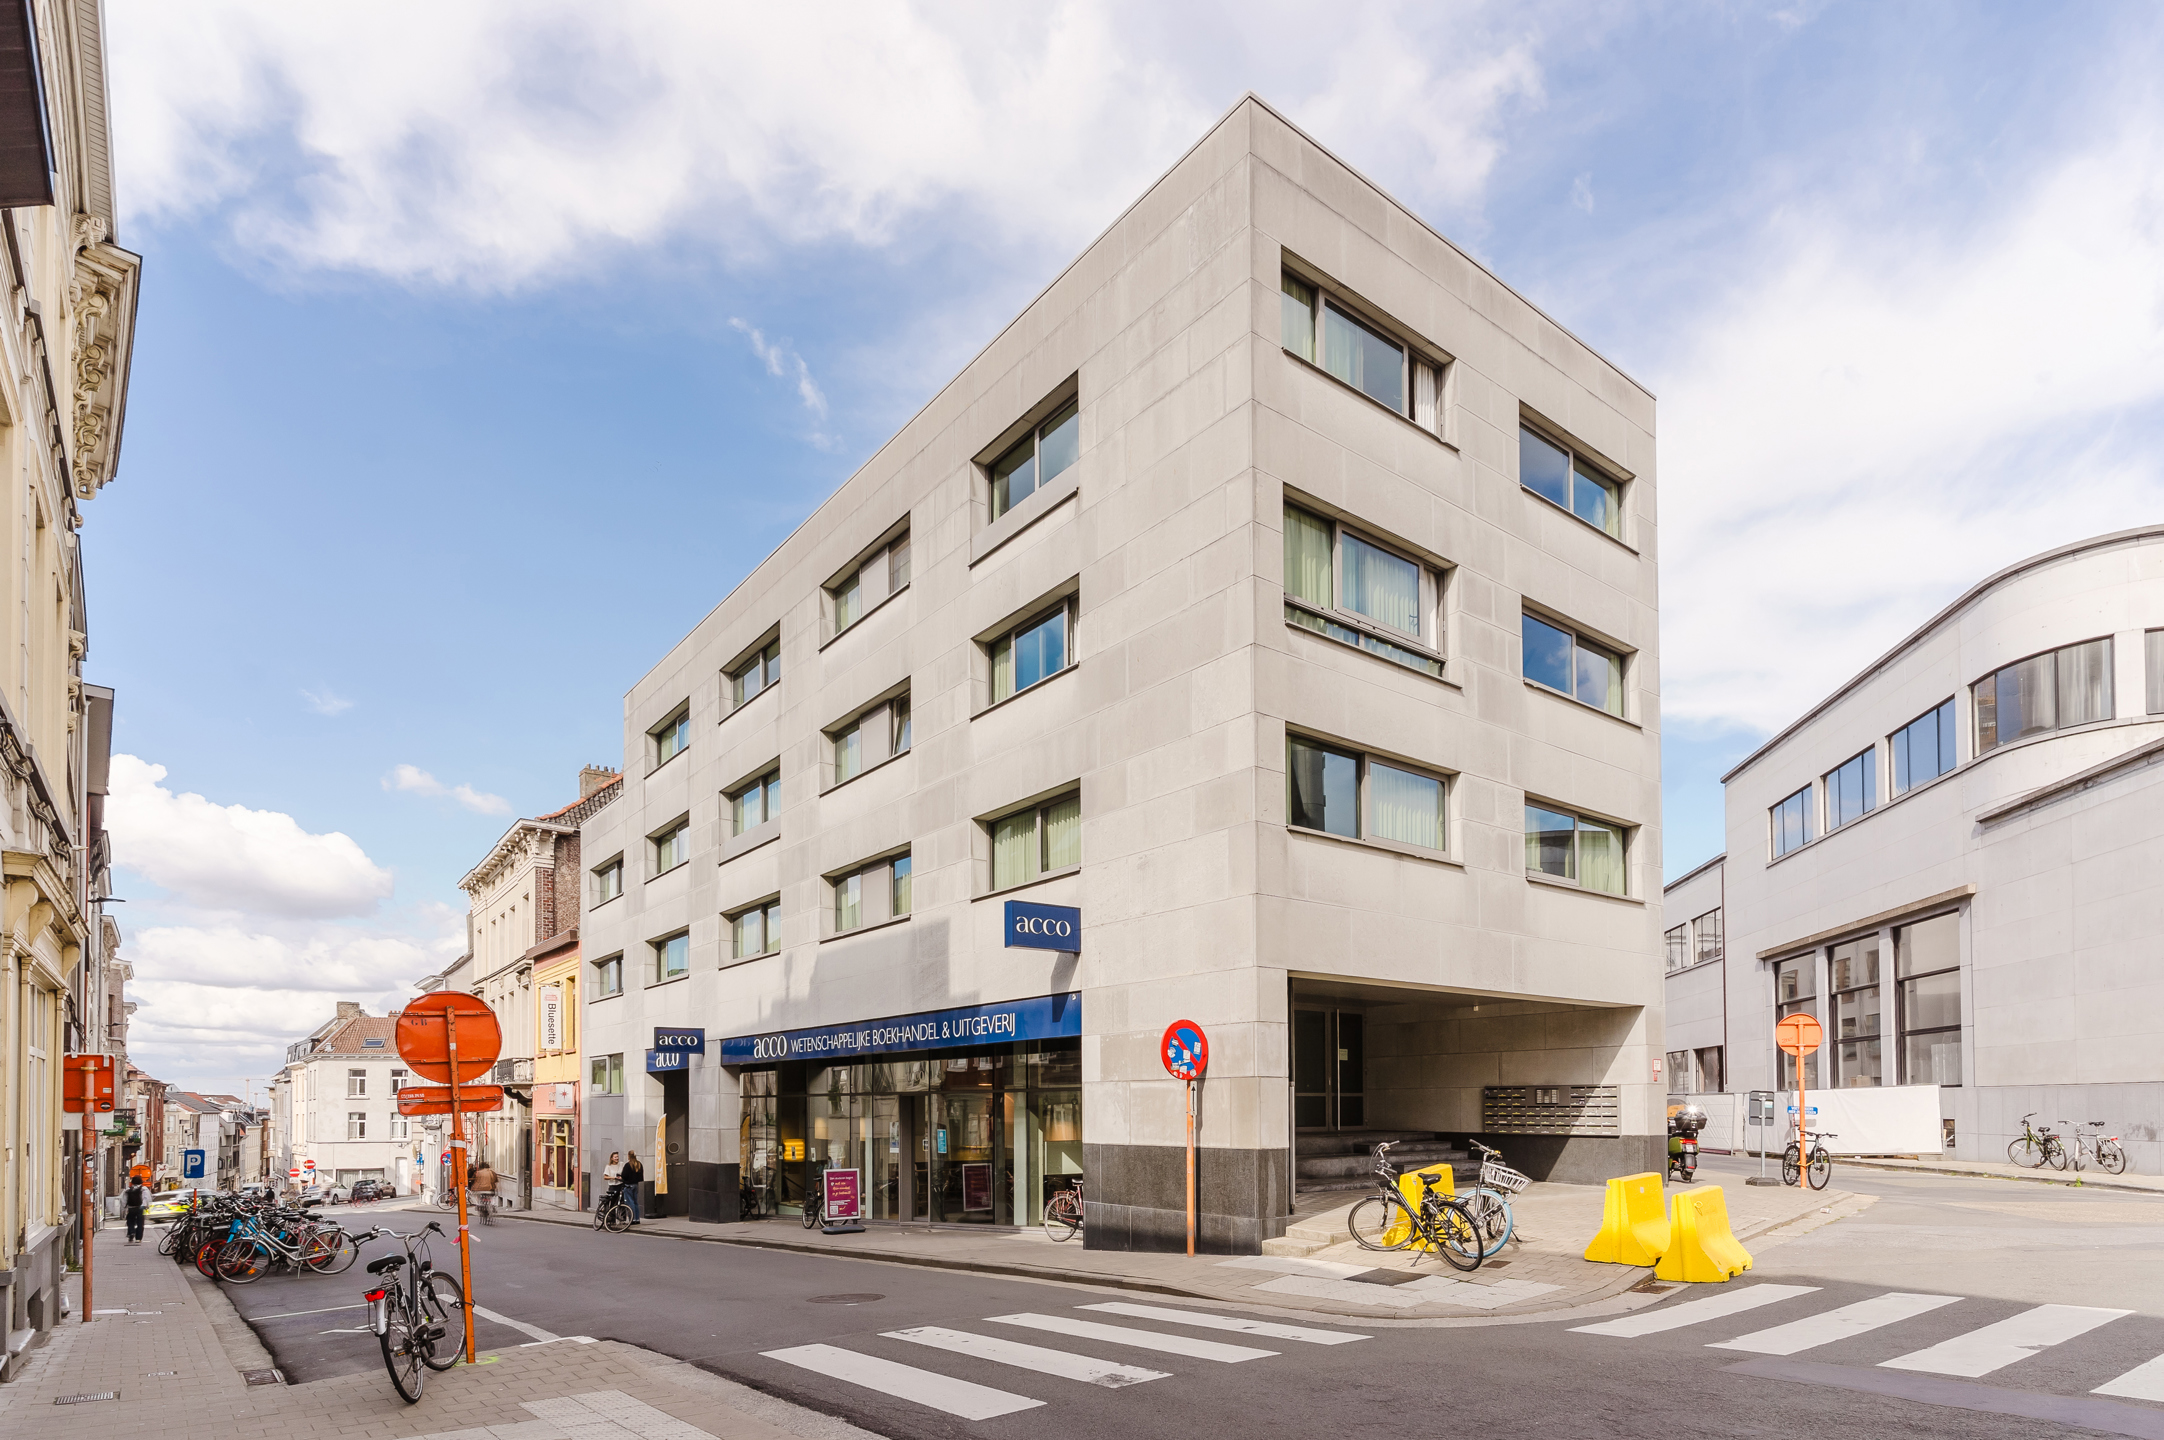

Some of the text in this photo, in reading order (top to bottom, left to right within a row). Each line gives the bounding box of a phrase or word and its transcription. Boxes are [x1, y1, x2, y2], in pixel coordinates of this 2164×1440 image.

[1016, 916, 1071, 937] acco
[547, 1003, 557, 1045] Bluesette
[659, 1035, 698, 1046] acco
[753, 1012, 1016, 1059] acco WETENSCHAPPELIJKE BOEKHANDEL & UITGEVERIJ
[186, 1154, 202, 1175] P
